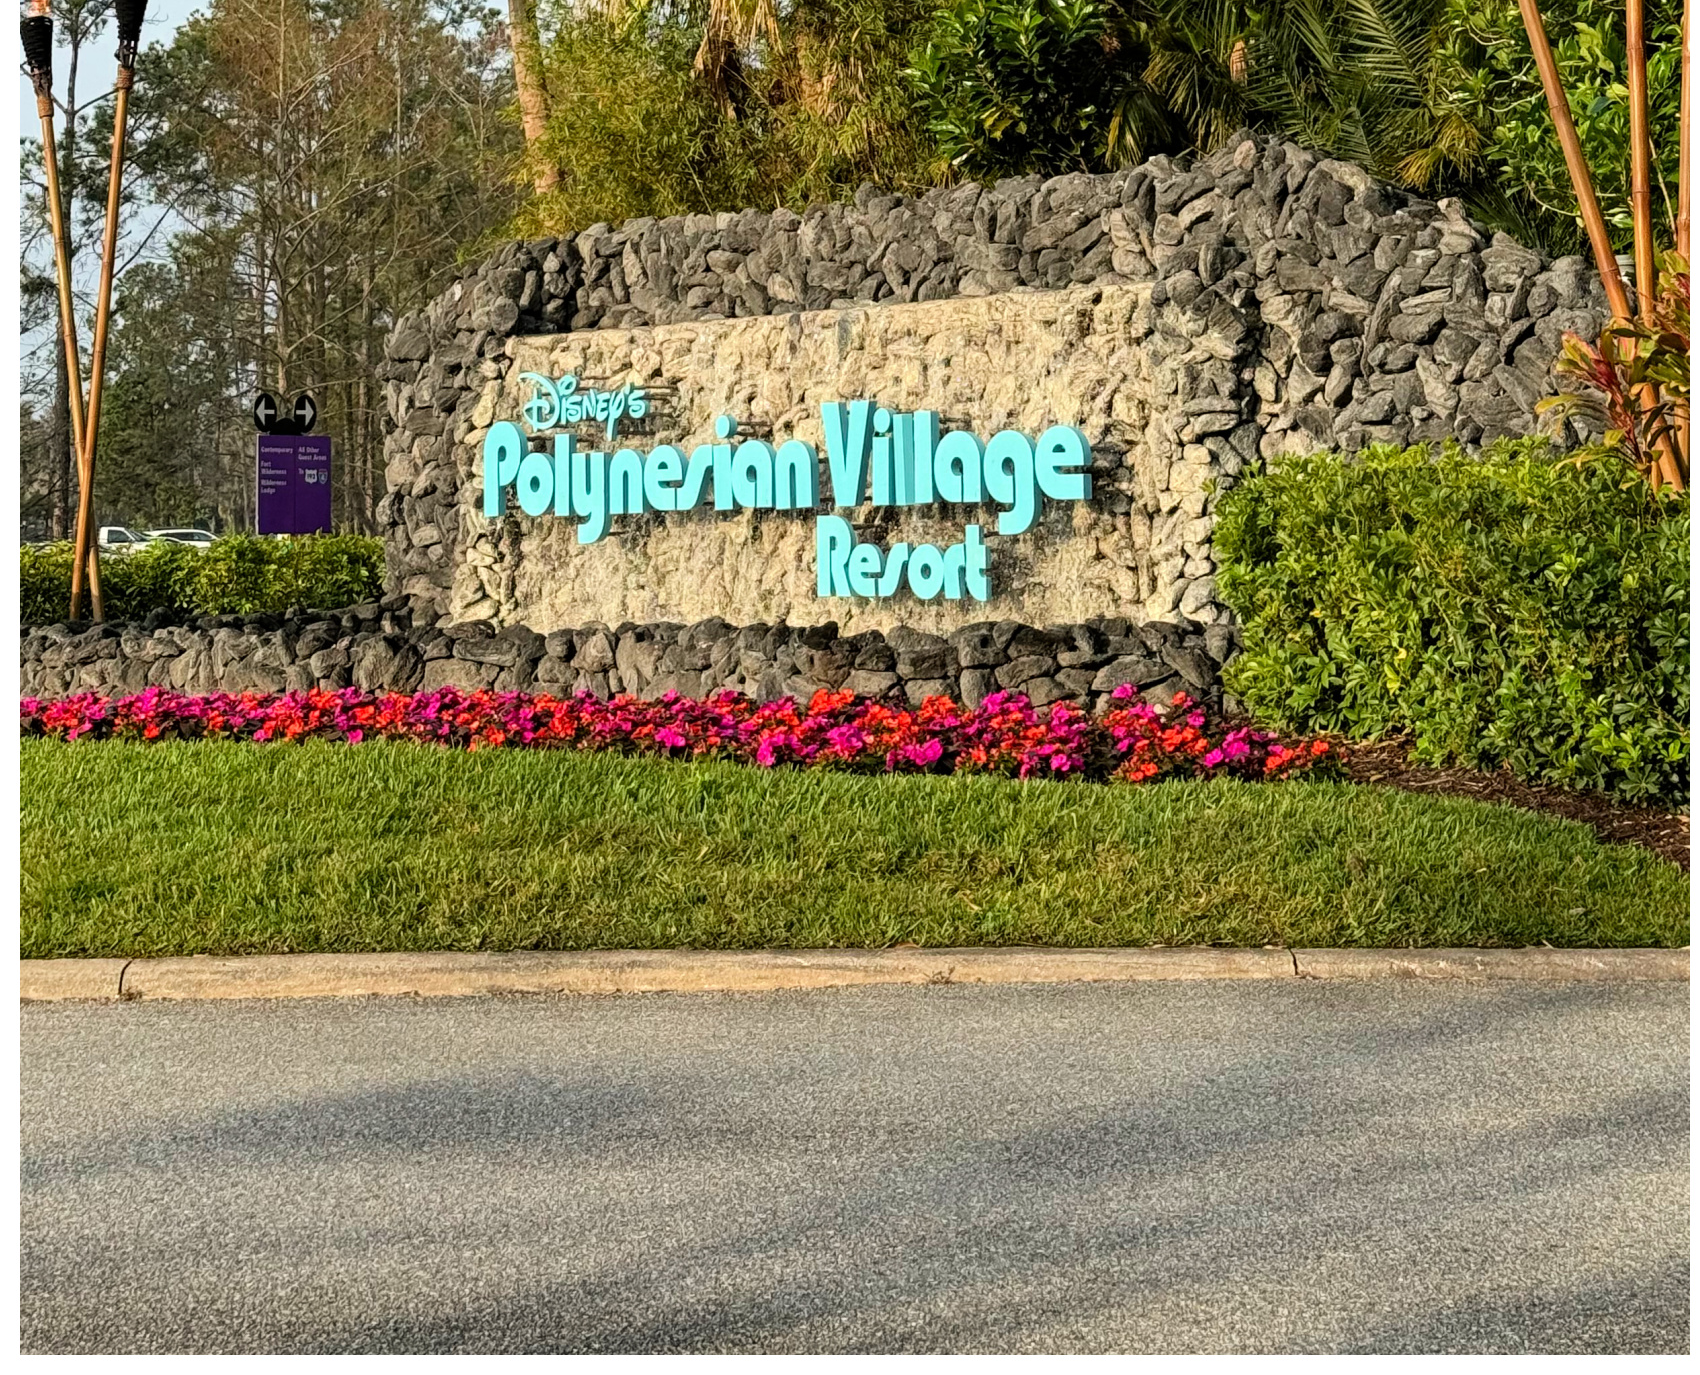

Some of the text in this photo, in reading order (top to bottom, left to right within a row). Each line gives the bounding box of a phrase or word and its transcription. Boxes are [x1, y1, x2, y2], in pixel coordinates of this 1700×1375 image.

[517, 371, 648, 442] Disney's
[483, 399, 1093, 544] Polynesian Village
[816, 514, 993, 601] Resort
